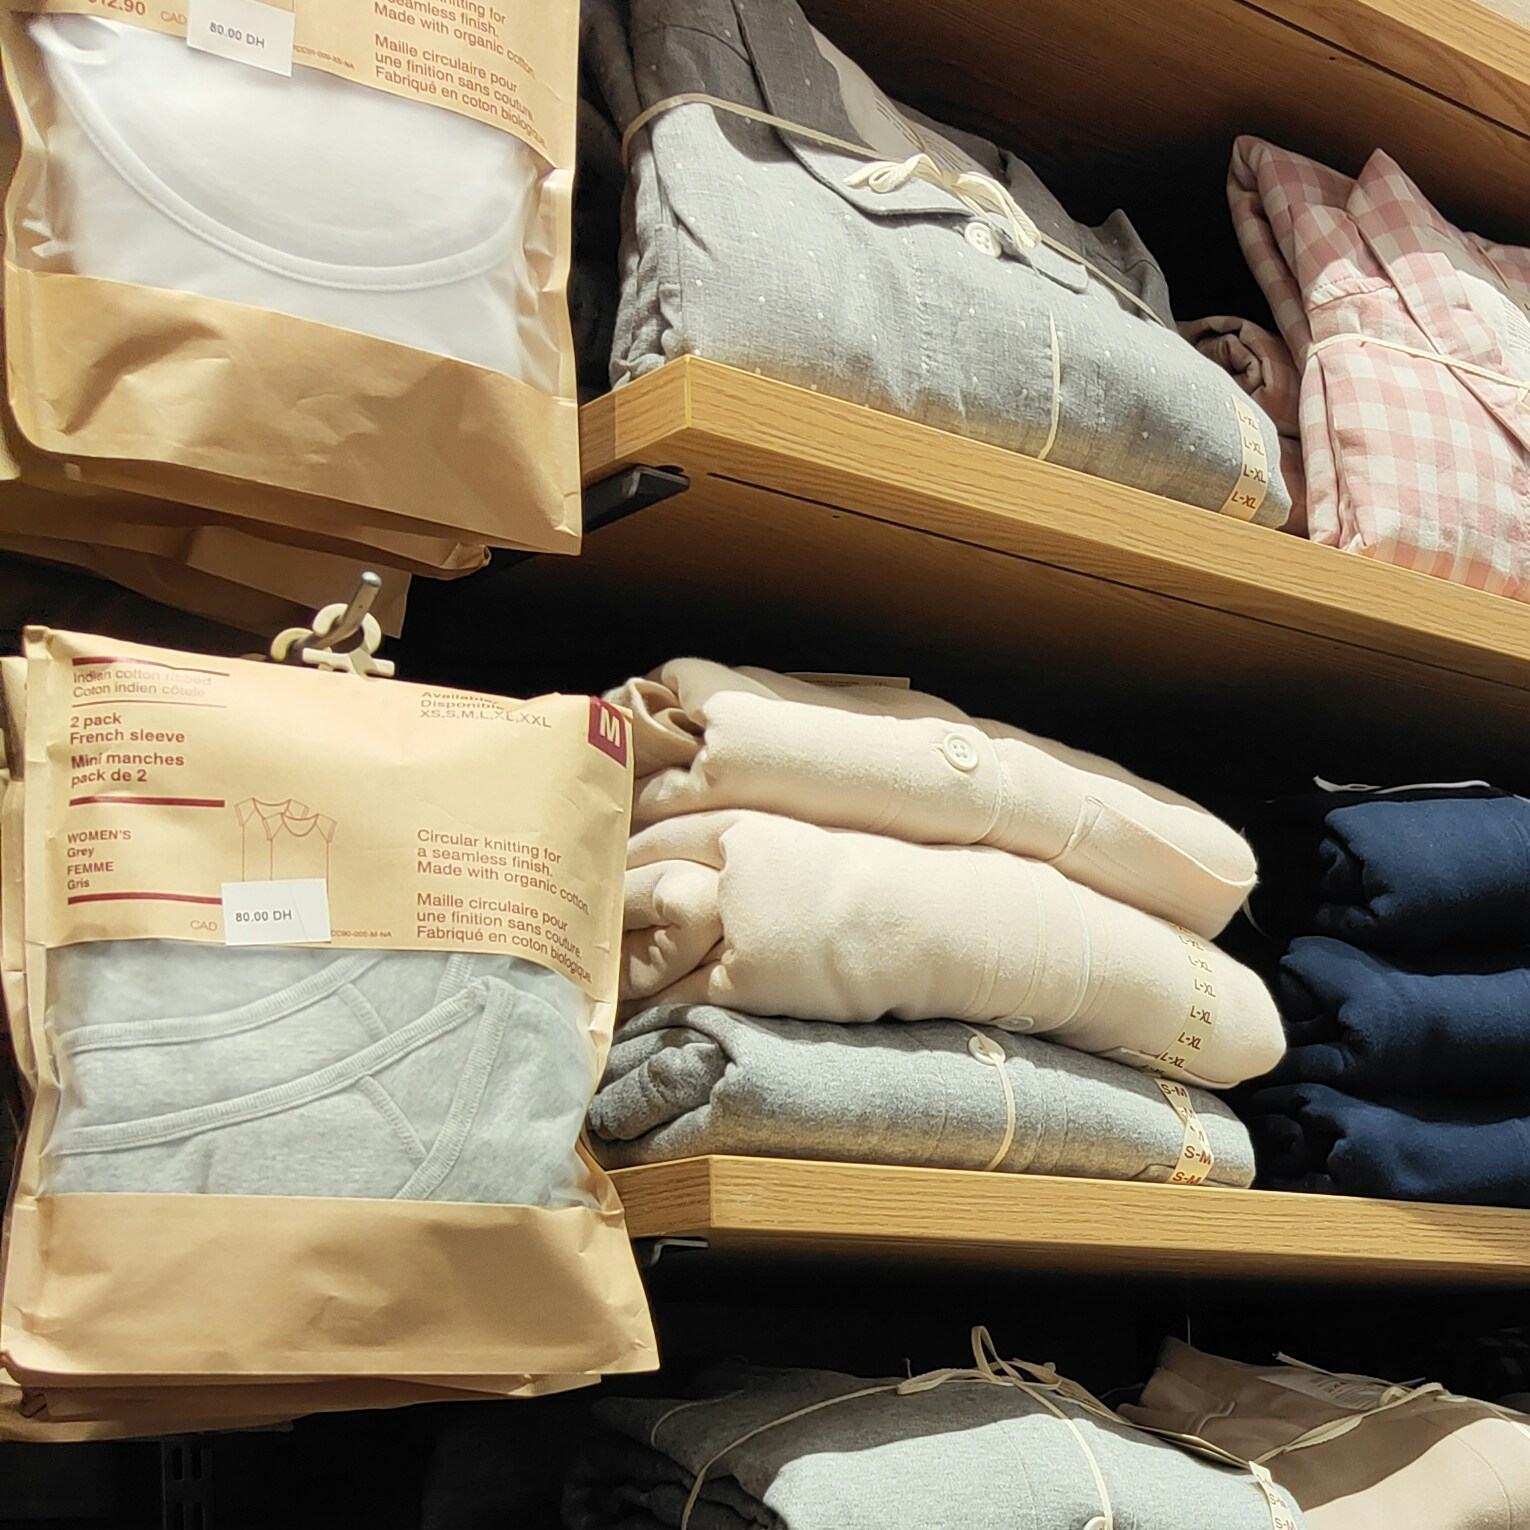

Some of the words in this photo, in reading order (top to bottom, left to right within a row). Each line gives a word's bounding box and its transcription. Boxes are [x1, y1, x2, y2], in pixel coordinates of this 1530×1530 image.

[160, 10, 188, 25] CAD
[490, 7, 506, 25] for
[375, 3, 415, 25] Made
[421, 17, 449, 35] with
[454, 28, 504, 55] organic
[461, 14, 499, 37] finish.
[209, 22, 242, 41] 80.00
[247, 34, 265, 48] DH
[375, 34, 417, 57] Maille
[423, 50, 486, 78] circulaire
[491, 73, 517, 93] pour
[375, 52, 401, 68] une
[407, 60, 454, 83] finition
[458, 77, 489, 96] sans
[376, 65, 436, 94] Fabriqué
[441, 88, 458, 100] en
[463, 95, 497, 115] coton
[1238, 411, 1258, 430] L-XL
[1244, 436, 1264, 456] L-XL
[1243, 464, 1266, 483] L-XL
[1231, 491, 1256, 509] L-XL
[73, 670, 111, 684] Indian
[116, 670, 160, 680] cotton
[165, 673, 211, 686] ribbed
[73, 684, 110, 698] Coton
[115, 683, 157, 693] indien
[162, 684, 206, 697] côtelé
[70, 716, 79, 728] 2
[84, 713, 122, 729] pack
[600, 707, 620, 747] M
[70, 729, 124, 745] French
[130, 729, 185, 742] sleeve
[72, 752, 102, 770] Mini
[107, 752, 184, 766] manches
[72, 770, 105, 788] pack
[111, 769, 131, 782] de
[137, 770, 147, 782] 2
[68, 830, 131, 843] WOMEN'S
[67, 847, 95, 858] Grey
[417, 829, 480, 847] Circular
[484, 837, 539, 859] knitting
[544, 848, 562, 864] for
[68, 862, 114, 875] FEMME
[417, 848, 426, 857] a
[432, 848, 507, 866] seamless
[512, 856, 553, 877] finish.
[68, 879, 89, 890] Gris
[417, 861, 462, 876] Made
[468, 867, 499, 880] with
[504, 873, 557, 894] organic
[235, 911, 269, 922] 80.00
[273, 910, 292, 921] DH
[417, 893, 463, 907] Maille
[469, 898, 538, 918] circulaire
[542, 912, 568, 932] pour
[190, 920, 218, 932] CAD
[417, 912, 445, 922] une
[452, 912, 502, 926] finition
[508, 918, 541, 936] sans
[417, 926, 483, 943] Fabriqué
[489, 933, 506, 943] en
[512, 936, 547, 954] coton
[1188, 955, 1213, 972] L-XL
[1194, 978, 1216, 998] L-XL
[1190, 1006, 1212, 1024] L-XL
[1178, 1032, 1201, 1050] L-XL
[1160, 1052, 1185, 1068] L-XL
[1161, 1084, 1187, 1098] S-M
[1184, 1145, 1211, 1165] S-M
